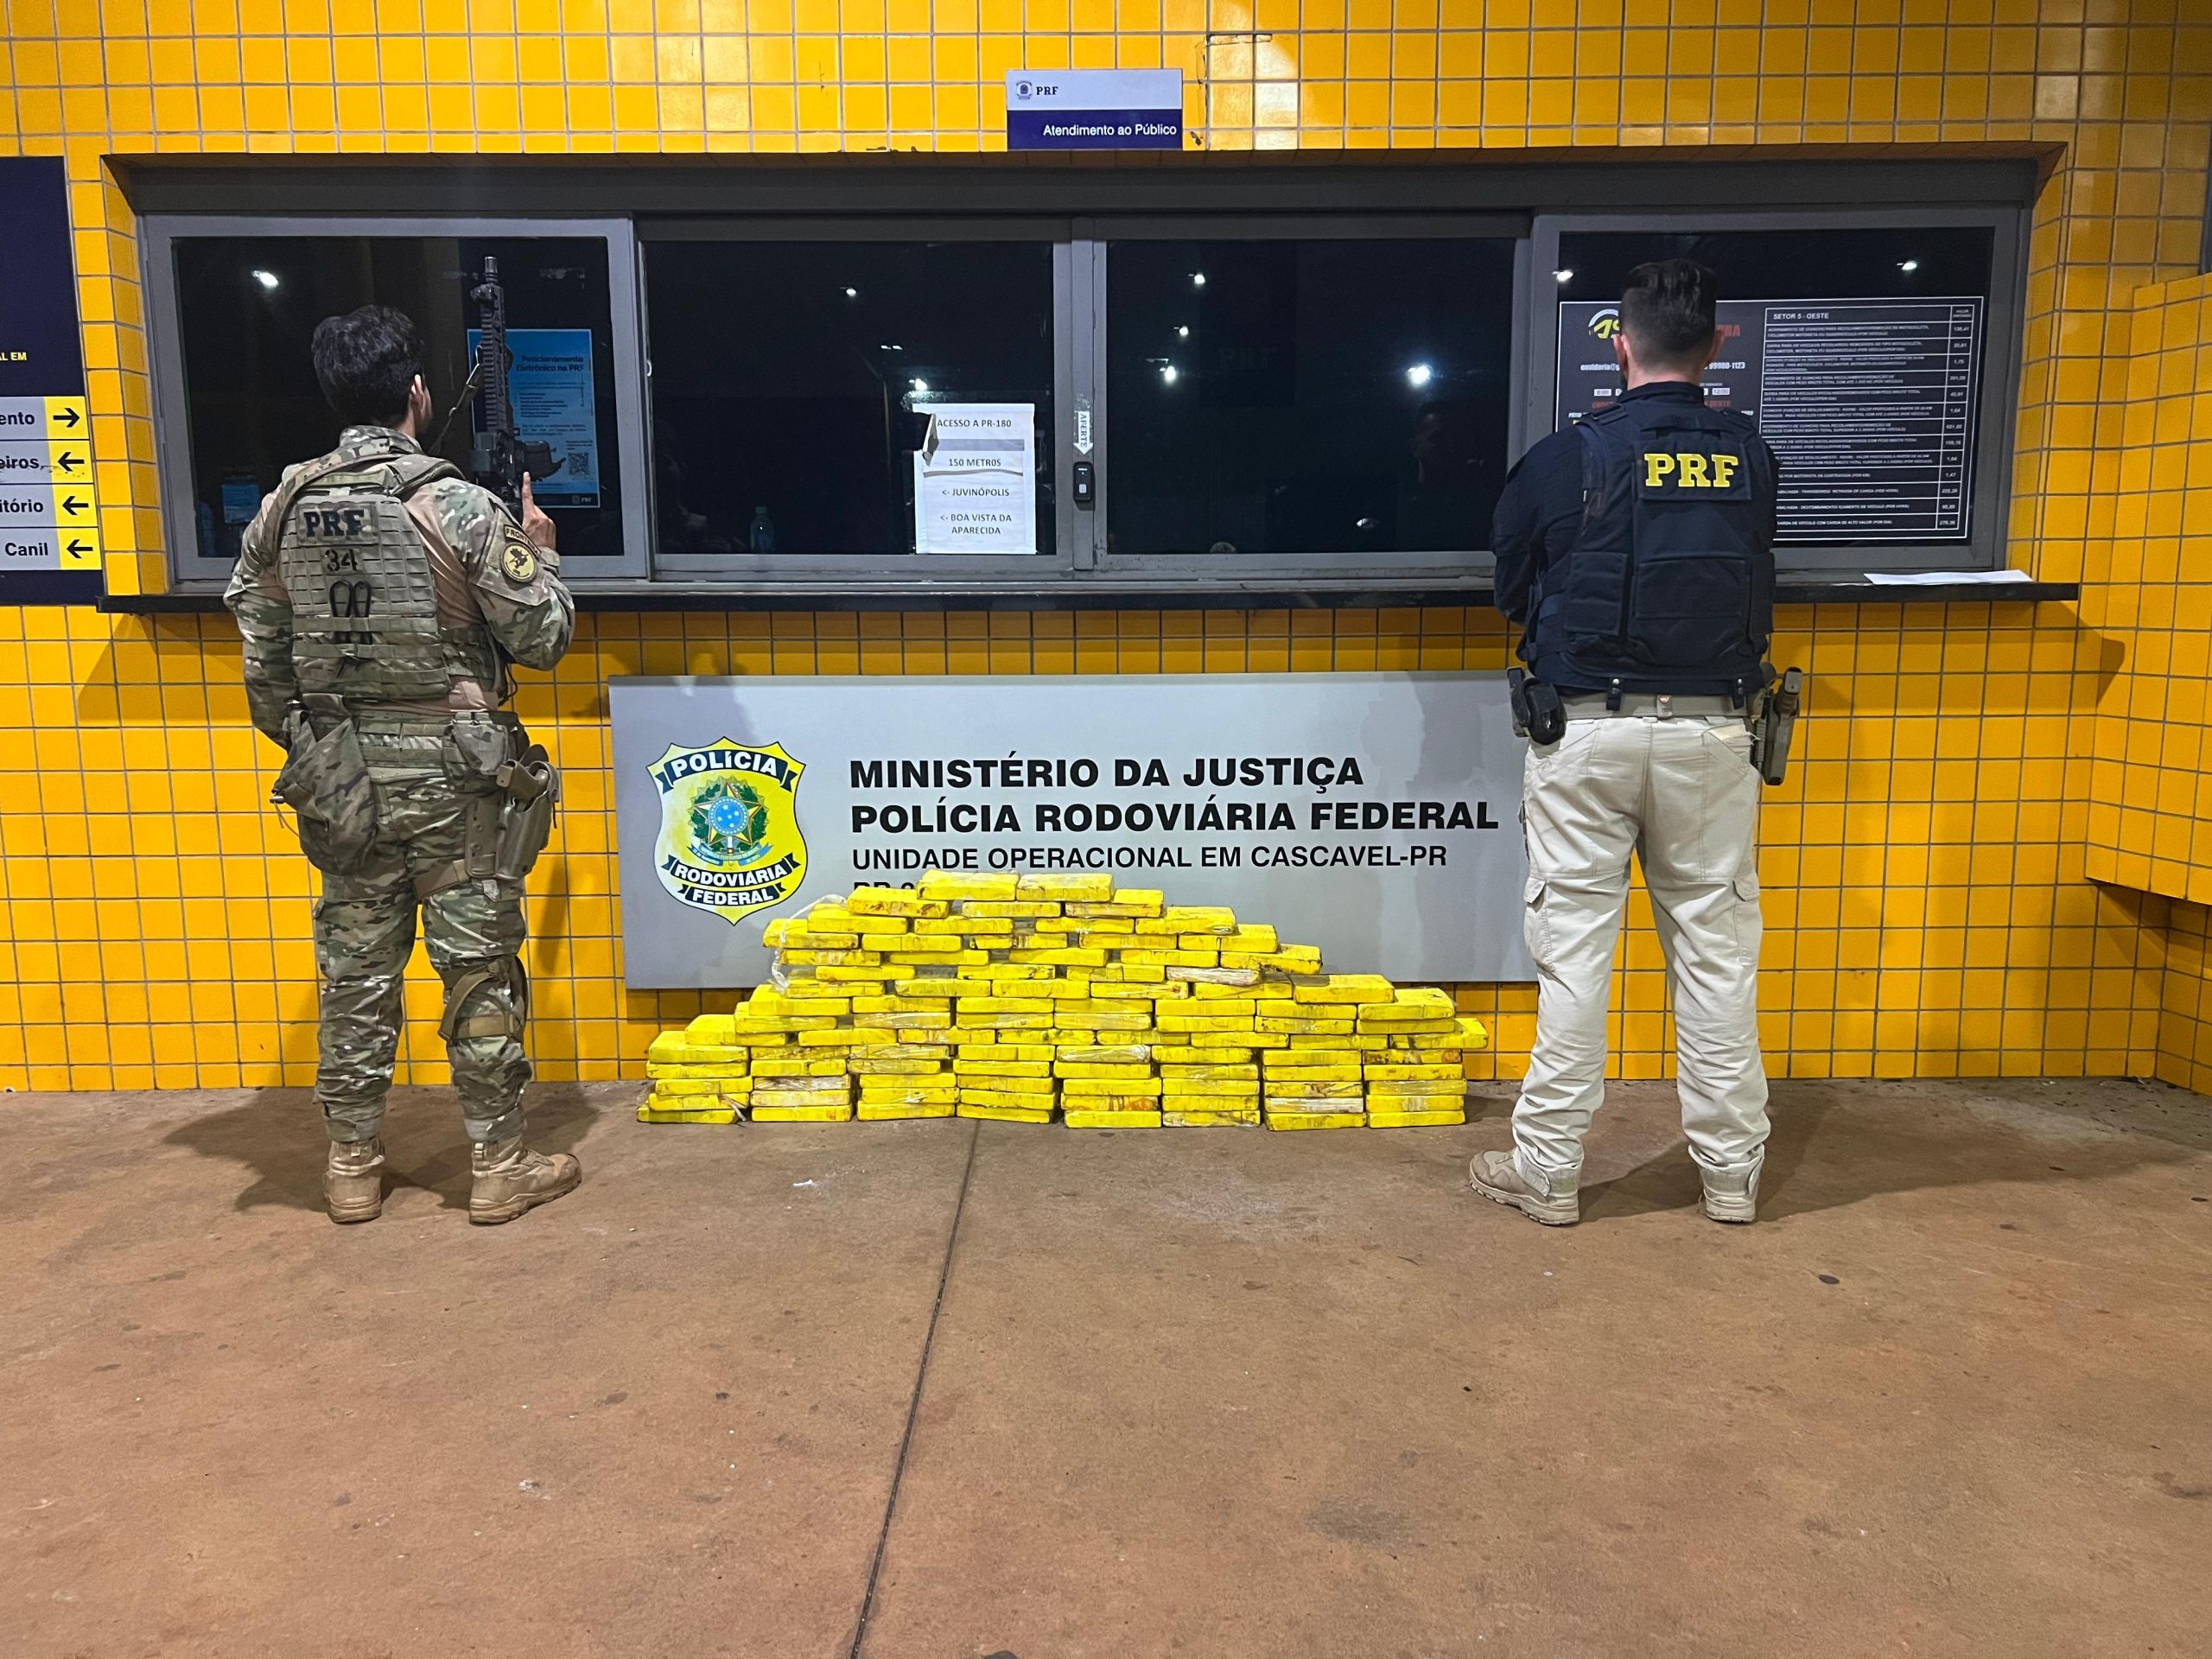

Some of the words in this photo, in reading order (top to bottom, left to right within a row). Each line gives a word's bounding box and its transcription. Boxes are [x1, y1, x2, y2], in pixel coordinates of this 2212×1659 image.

[1036, 86, 1059, 96] PRF
[1043, 124, 1116, 137] Atendimento
[1117, 126, 1133, 136] ao
[1135, 122, 1177, 136] Público
[10, 352, 28, 361] EM
[0, 411, 35, 425] ento
[937, 419, 970, 428] ACESSO
[972, 419, 980, 428] A
[981, 419, 1012, 428] PR-180
[1079, 413, 1088, 448] APERTE
[949, 458, 964, 467] 150
[1643, 453, 1739, 488] PRF
[952, 486, 1010, 497] JUVINÓPOLIS
[0, 498, 44, 513] itório
[302, 509, 365, 537] PRF
[950, 513, 969, 522] BOA
[971, 513, 997, 522] VISTA
[999, 513, 1013, 522] DA
[951, 526, 1001, 535] APARECIDA
[4, 542, 49, 557] Canil
[325, 549, 359, 572] 34
[671, 750, 778, 779] POLÍCIA
[850, 751, 1099, 788] MINISTÉRIO
[1114, 759, 1170, 787] DA
[1183, 757, 1364, 794] JUSTIÇA
[851, 796, 1021, 834] POLÍCIA
[1035, 794, 1296, 833] RODOVIÁRIA
[1310, 801, 1499, 830] FEDERAL
[853, 849, 979, 870] UNIDADE
[987, 846, 1192, 869] OPERACIONAL
[1200, 846, 1242, 868] EM
[1250, 845, 1447, 868] CASCAVEL-PR
[673, 863, 788, 887] RODOVIÁRIA
[692, 888, 774, 906] FEDERAL
